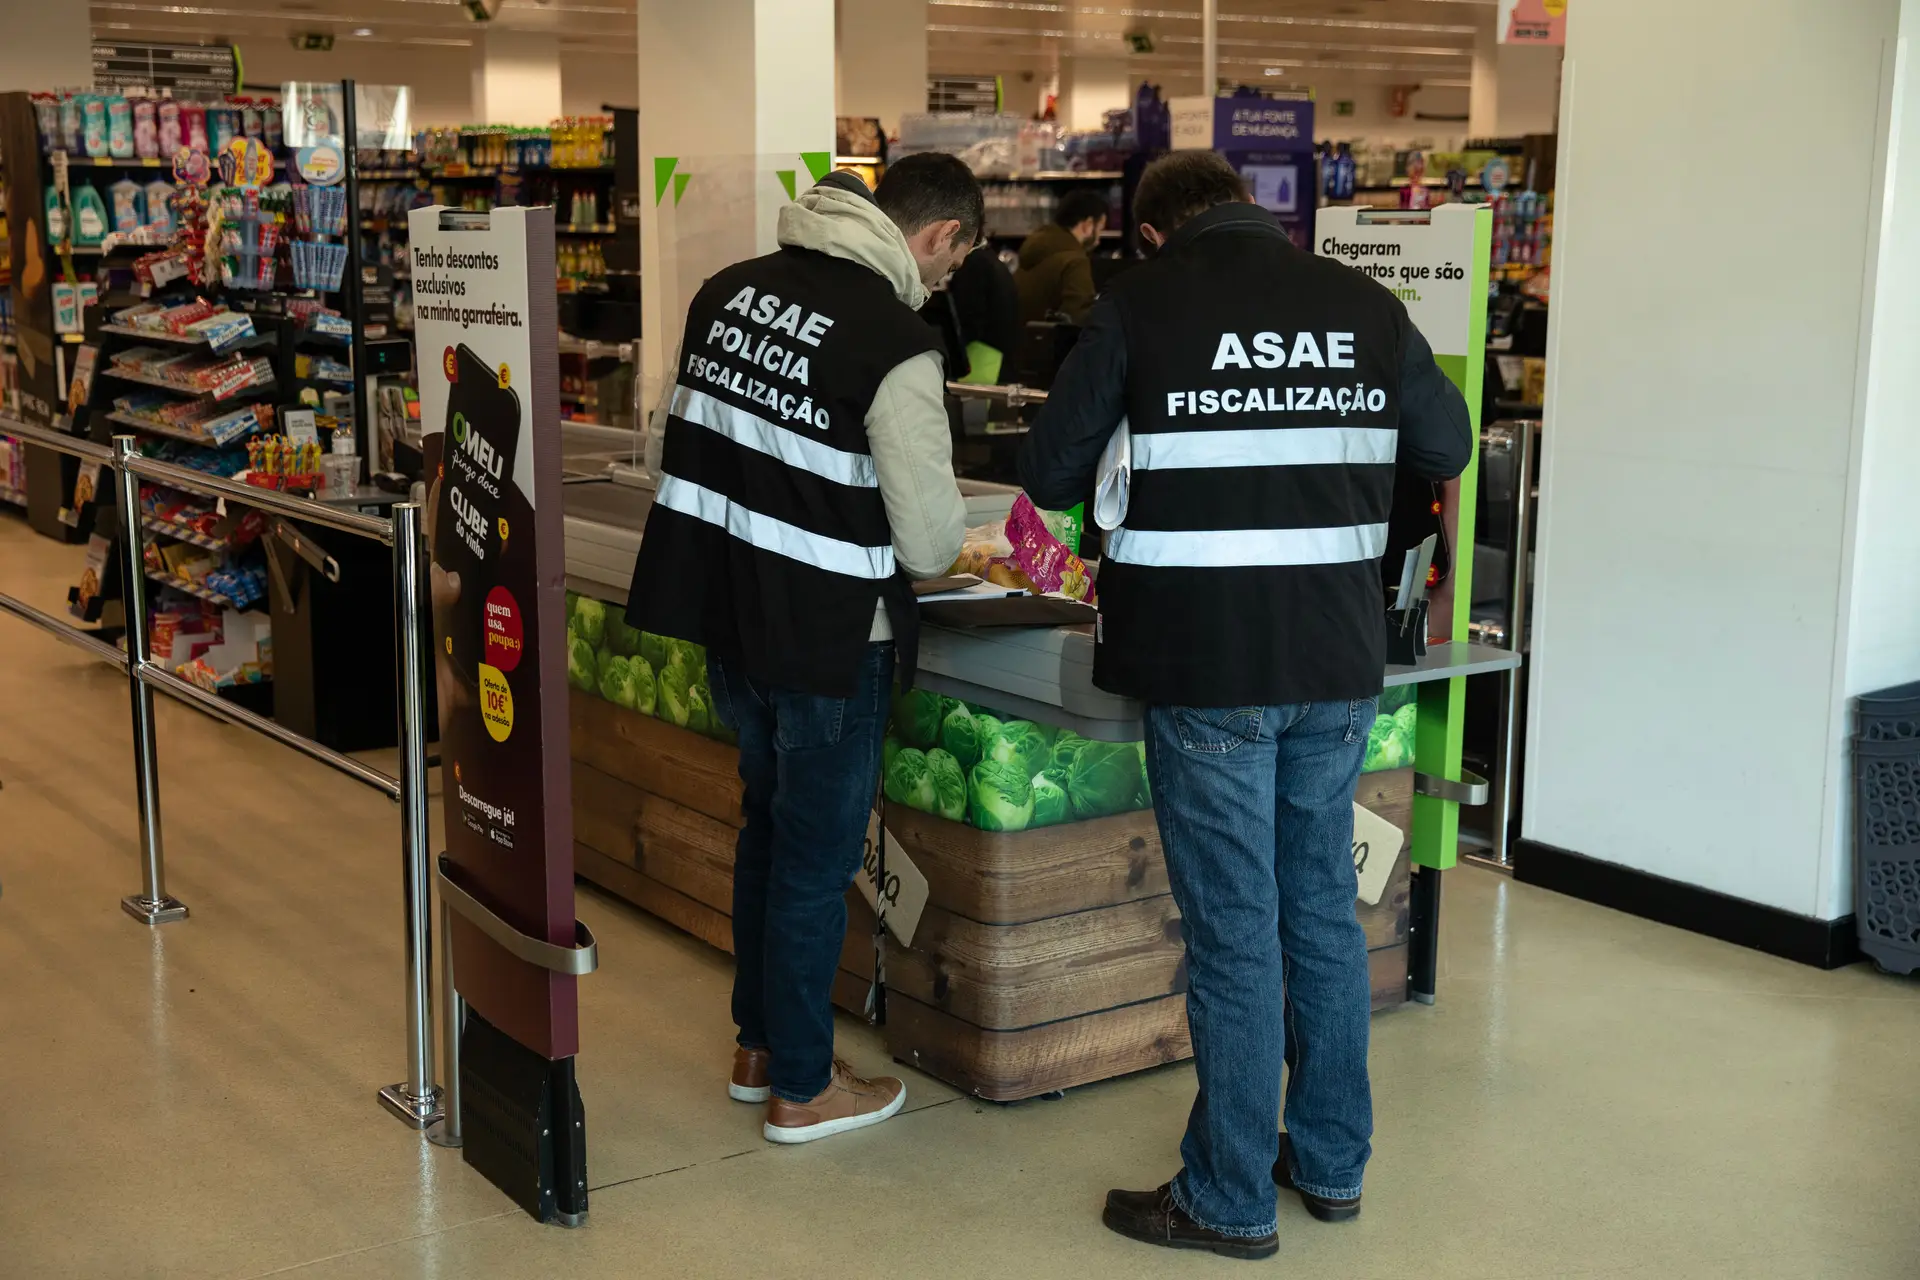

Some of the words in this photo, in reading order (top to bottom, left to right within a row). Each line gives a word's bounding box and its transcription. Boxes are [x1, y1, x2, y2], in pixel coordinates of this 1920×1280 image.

[414, 246, 443, 267] Tenho
[446, 246, 499, 270] descontos
[1322, 237, 1401, 260] Chegaram
[416, 272, 466, 296] exclusivos
[1400, 266, 1430, 283] que
[1434, 262, 1464, 280] são
[417, 304, 429, 319] na
[430, 300, 461, 322] minha
[462, 302, 522, 329] garrafeira.
[724, 285, 835, 348] ASAE
[706, 320, 810, 387] POLÍCIA
[1211, 332, 1355, 370] ASAE
[686, 353, 830, 430] FISCALIZAÇÃO
[1167, 383, 1386, 416] FISCALIZAÇÃO
[452, 450, 475, 482] pingo
[477, 472, 501, 499] doce
[450, 486, 489, 540] CLUBE
[456, 518, 464, 538] do
[466, 533, 485, 560] vinho
[487, 602, 511, 618] quem
[488, 618, 505, 632] usa,
[484, 678, 501, 692] Oferta
[501, 683, 508, 694] de
[459, 785, 502, 820] Descarregue
[503, 806, 515, 827] já!
